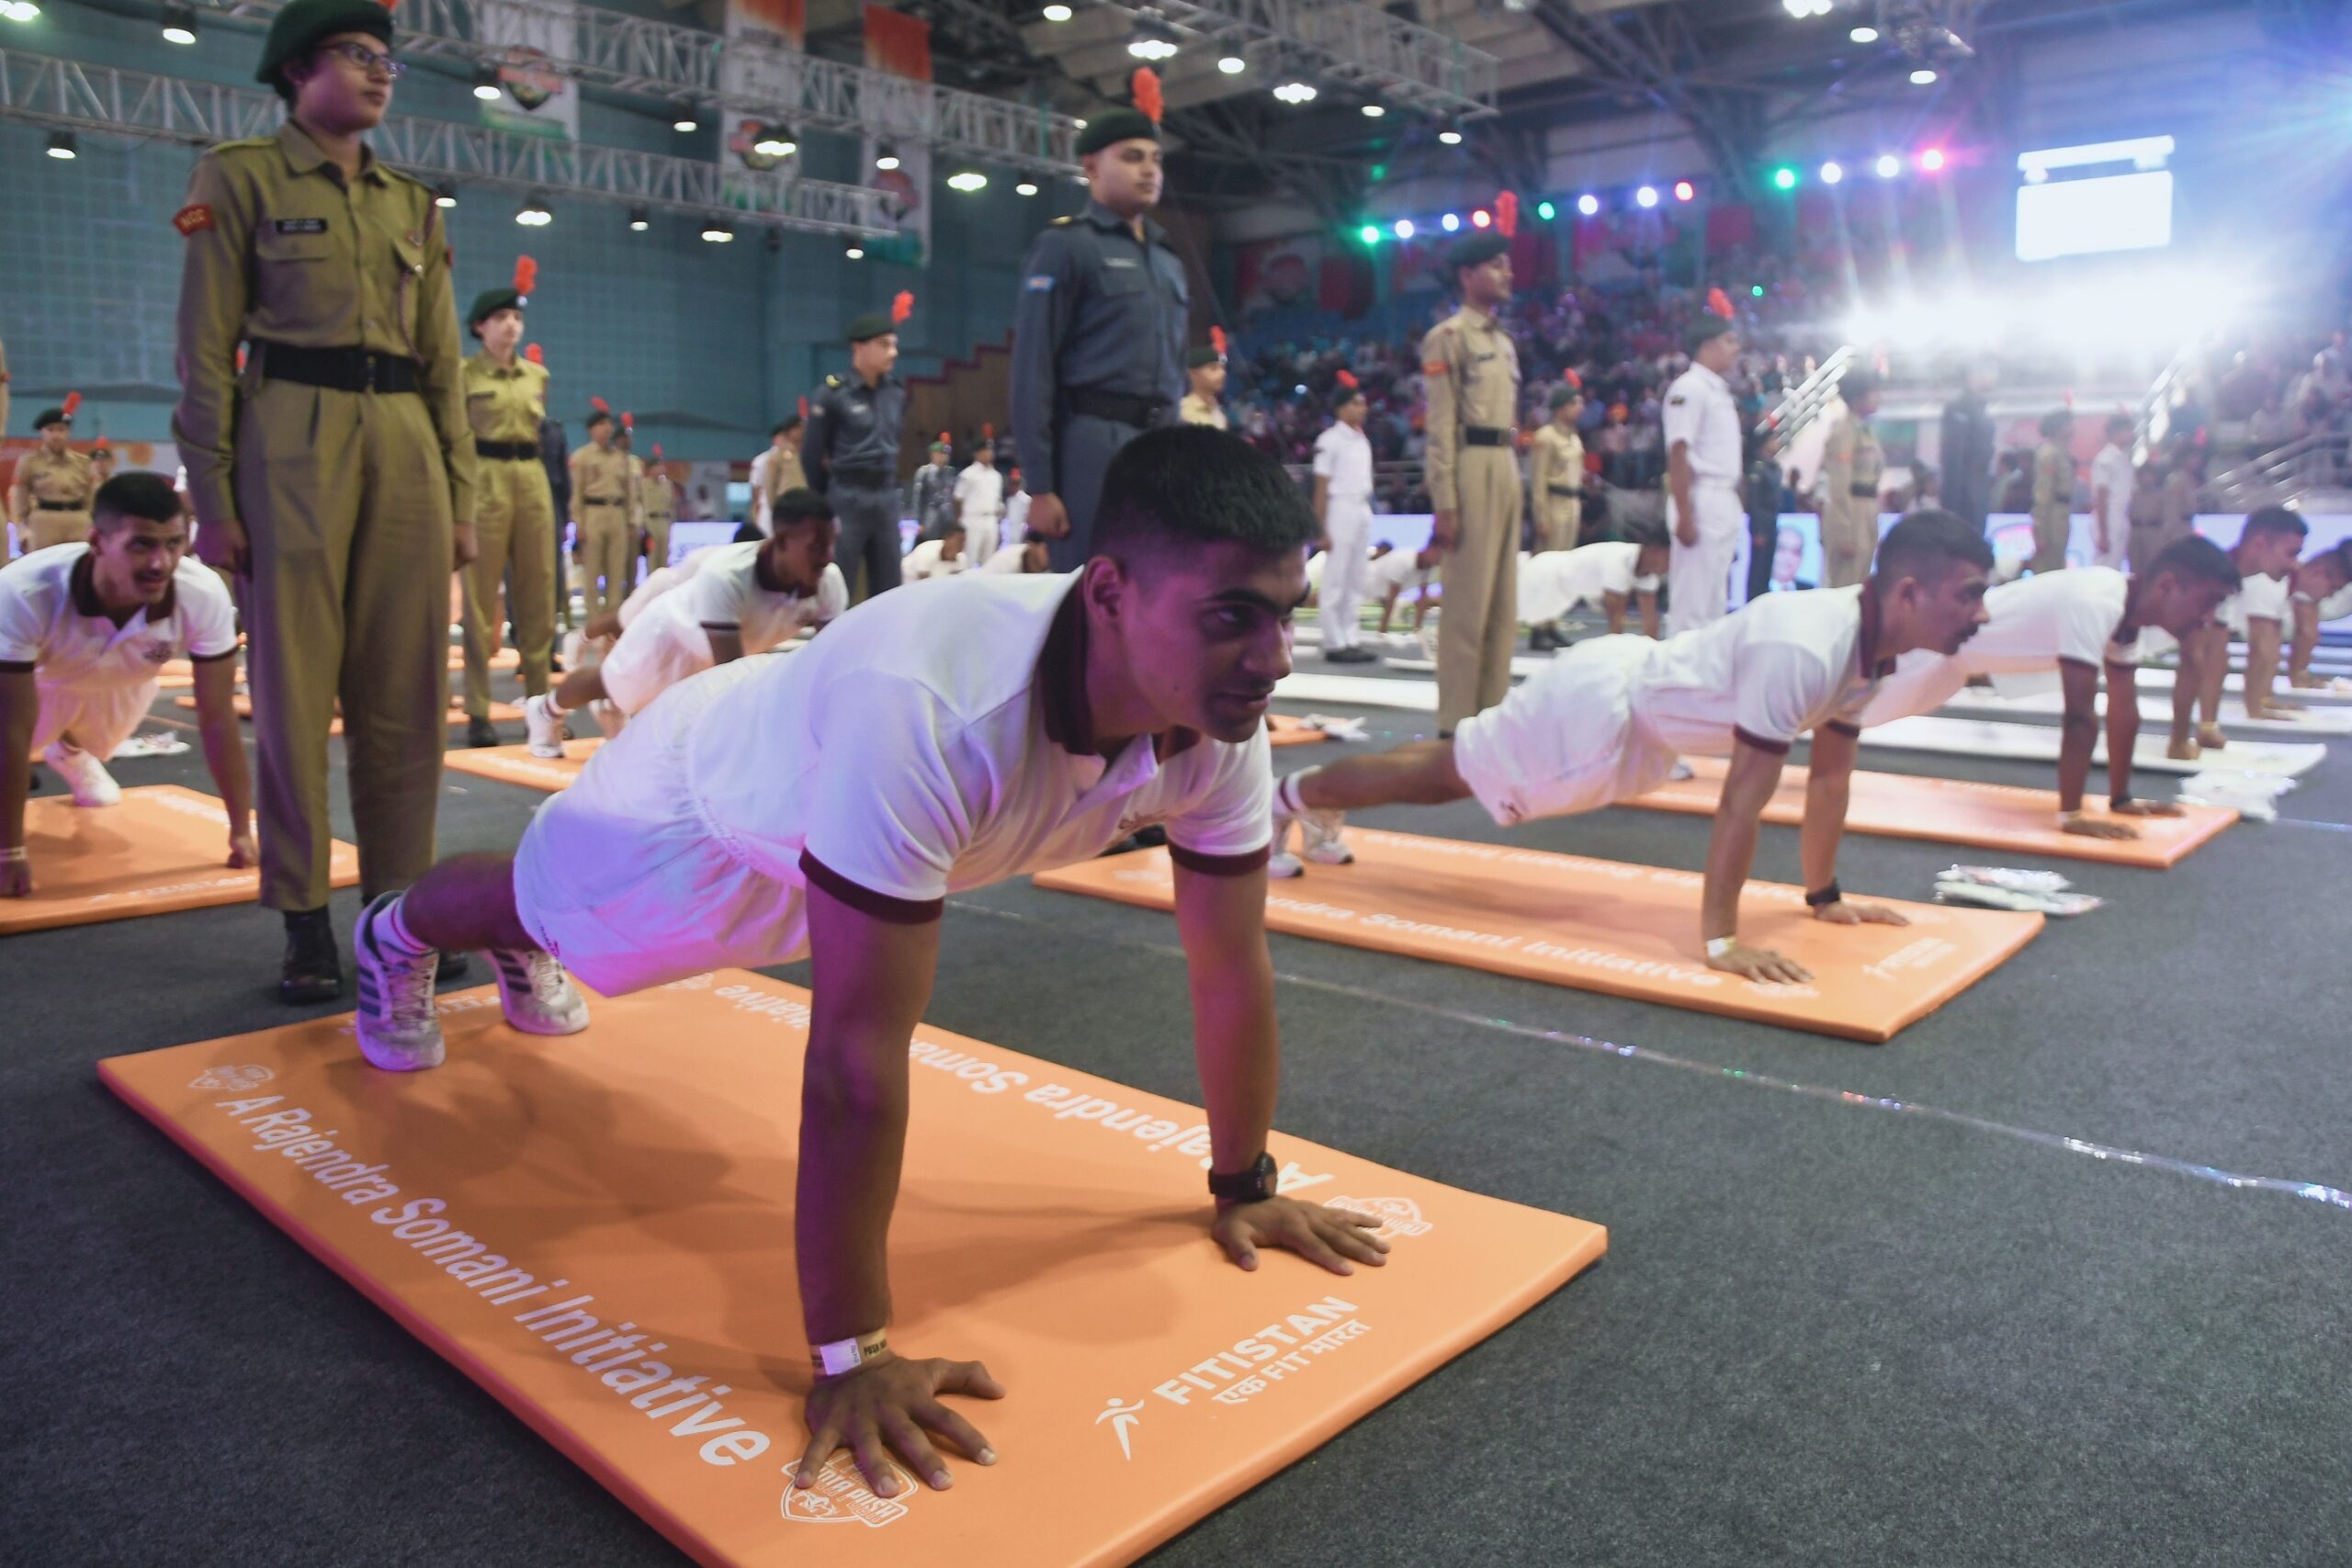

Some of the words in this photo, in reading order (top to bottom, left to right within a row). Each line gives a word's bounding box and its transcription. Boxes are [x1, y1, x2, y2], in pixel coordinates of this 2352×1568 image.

[1360, 913, 1522, 949] Somani
[215, 1095, 286, 1117] A
[908, 1038, 1029, 1094] Soma
[241, 1107, 401, 1205] Rajendra
[1024, 1082, 1213, 1170] ajendra
[370, 1197, 569, 1306] Somani
[514, 1294, 771, 1466] Initiative
[1152, 1295, 1360, 1405] FITISTAN
[1211, 1374, 1269, 1405] एक
[1260, 1350, 1311, 1381] FIT
[1301, 1318, 1373, 1354] भारत
